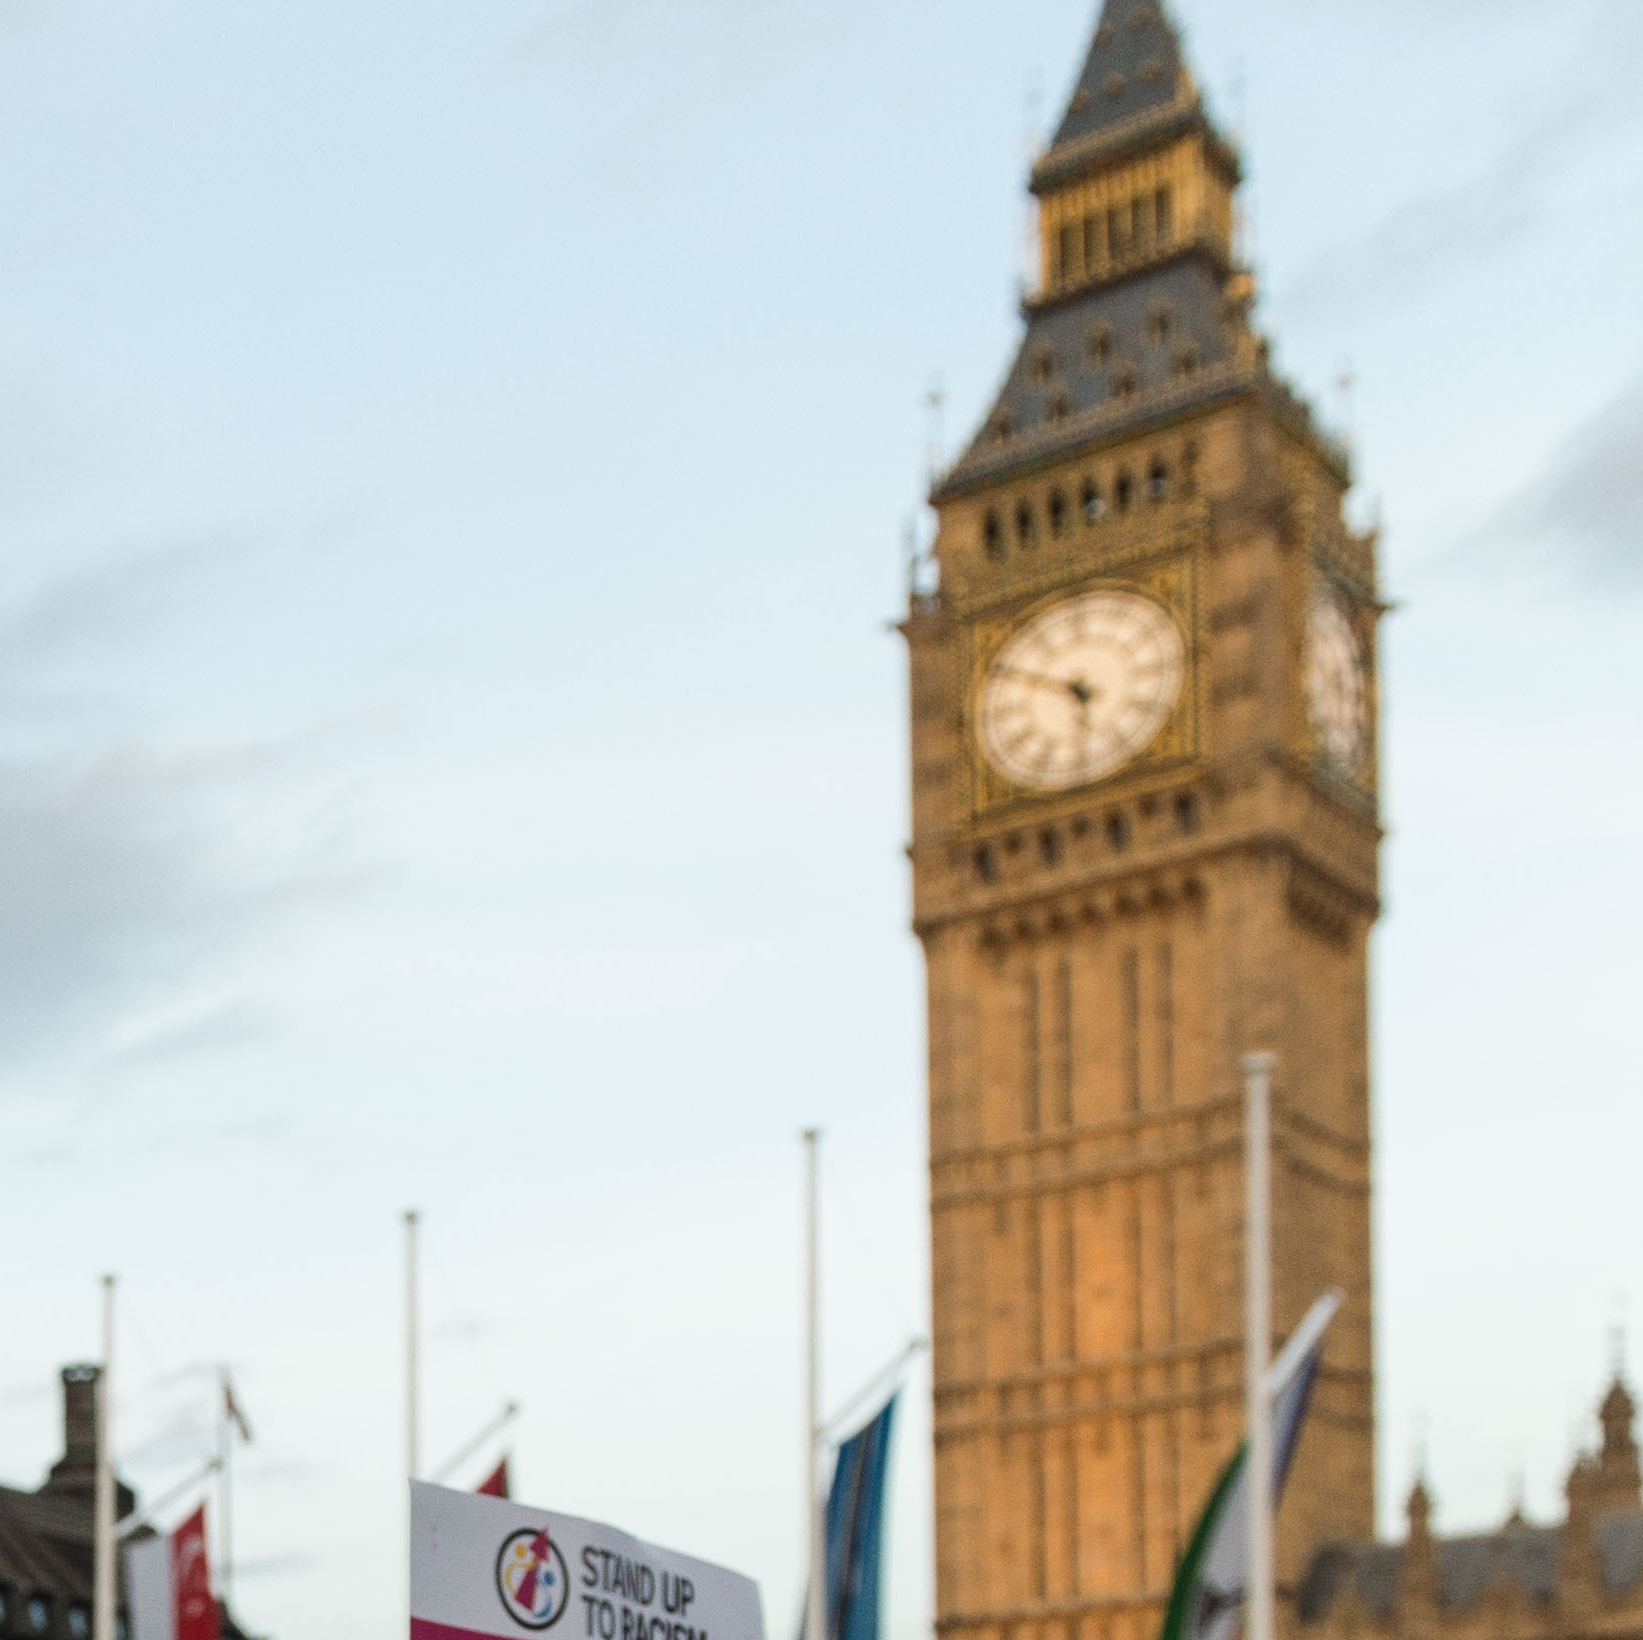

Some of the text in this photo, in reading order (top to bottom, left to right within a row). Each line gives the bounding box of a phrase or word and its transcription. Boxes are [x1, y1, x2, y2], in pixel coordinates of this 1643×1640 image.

[581, 1546, 694, 1616] STAND UP
[581, 1595, 616, 1640] TO
